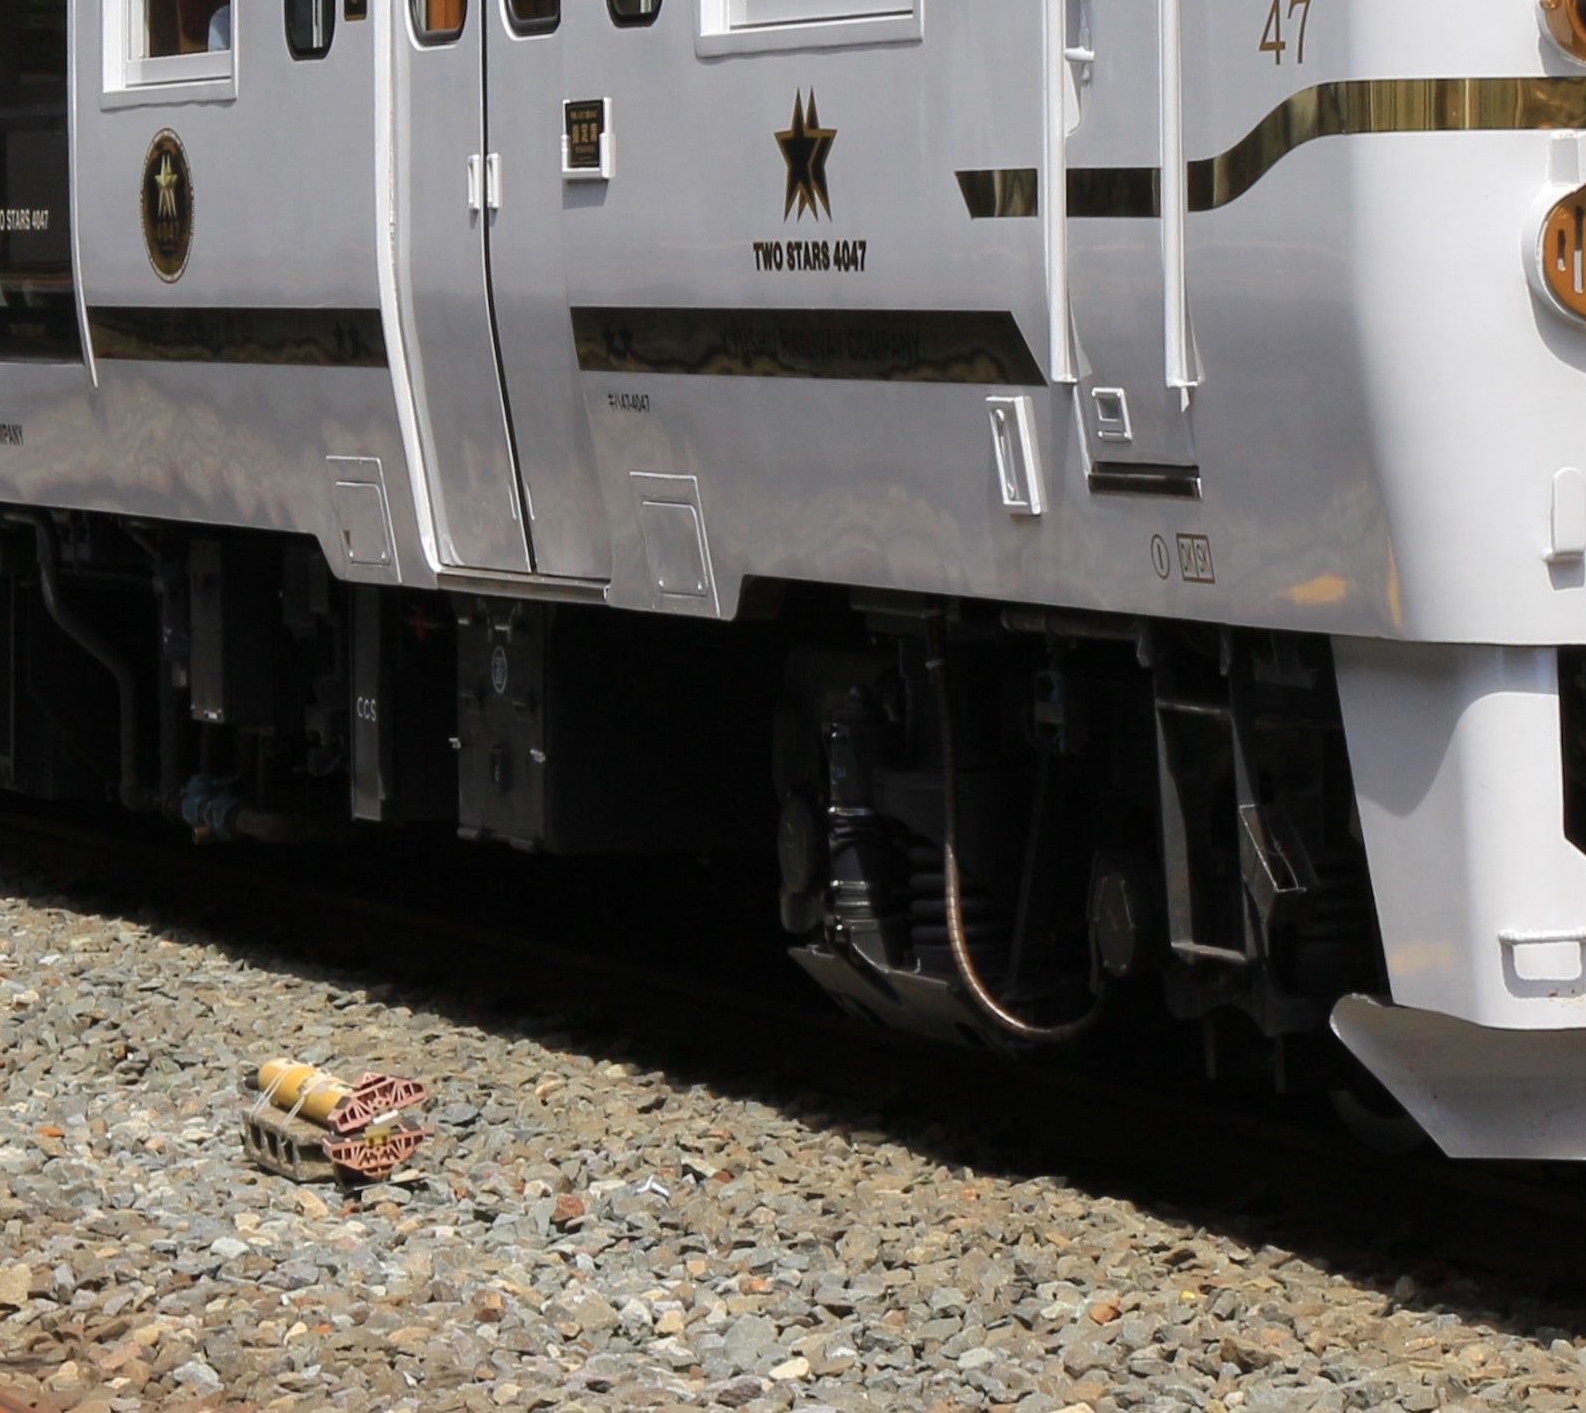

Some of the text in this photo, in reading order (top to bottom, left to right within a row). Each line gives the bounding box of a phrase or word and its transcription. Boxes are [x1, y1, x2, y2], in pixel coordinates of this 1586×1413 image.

[7, 209, 31, 231] STARS
[32, 209, 49, 230] 4047
[752, 240, 867, 272] TWO STARS 4047
[351, 696, 377, 723] CCS
